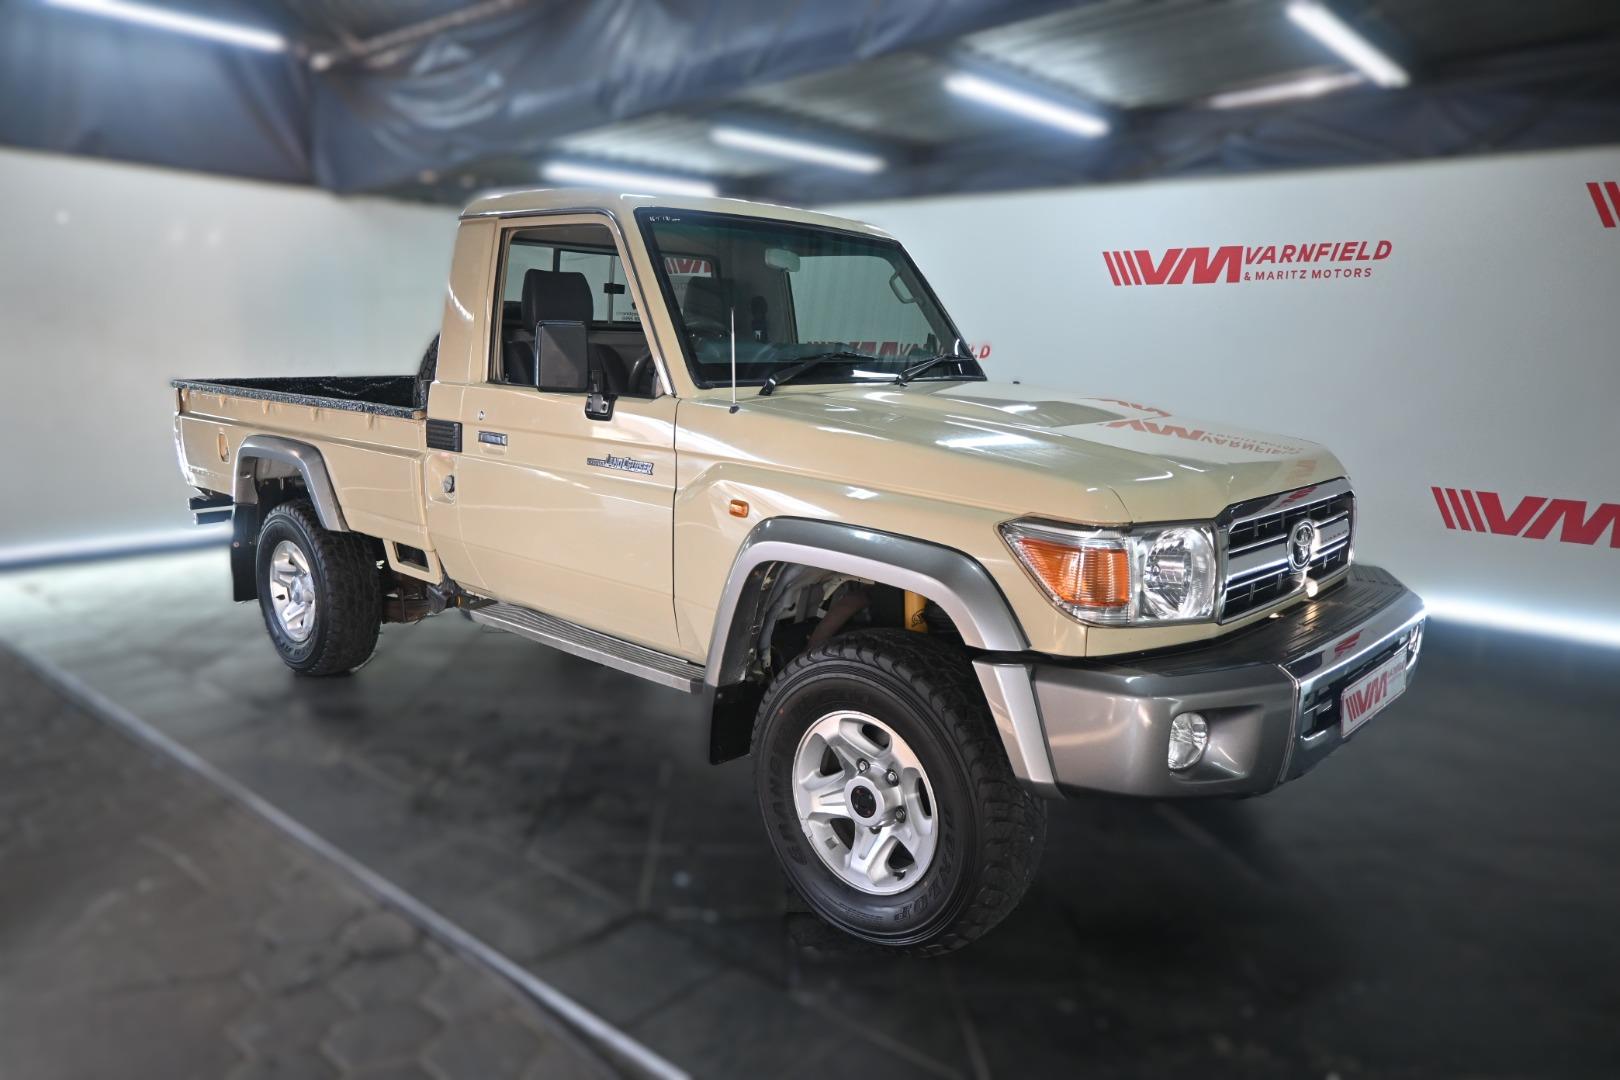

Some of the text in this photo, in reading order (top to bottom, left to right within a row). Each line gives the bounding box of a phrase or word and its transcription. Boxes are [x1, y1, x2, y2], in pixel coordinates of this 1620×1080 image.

[1133, 246, 1244, 286] VM
[1245, 239, 1393, 266] VARNFIELD
[1243, 267, 1373, 282] & MARITZ MOTORS
